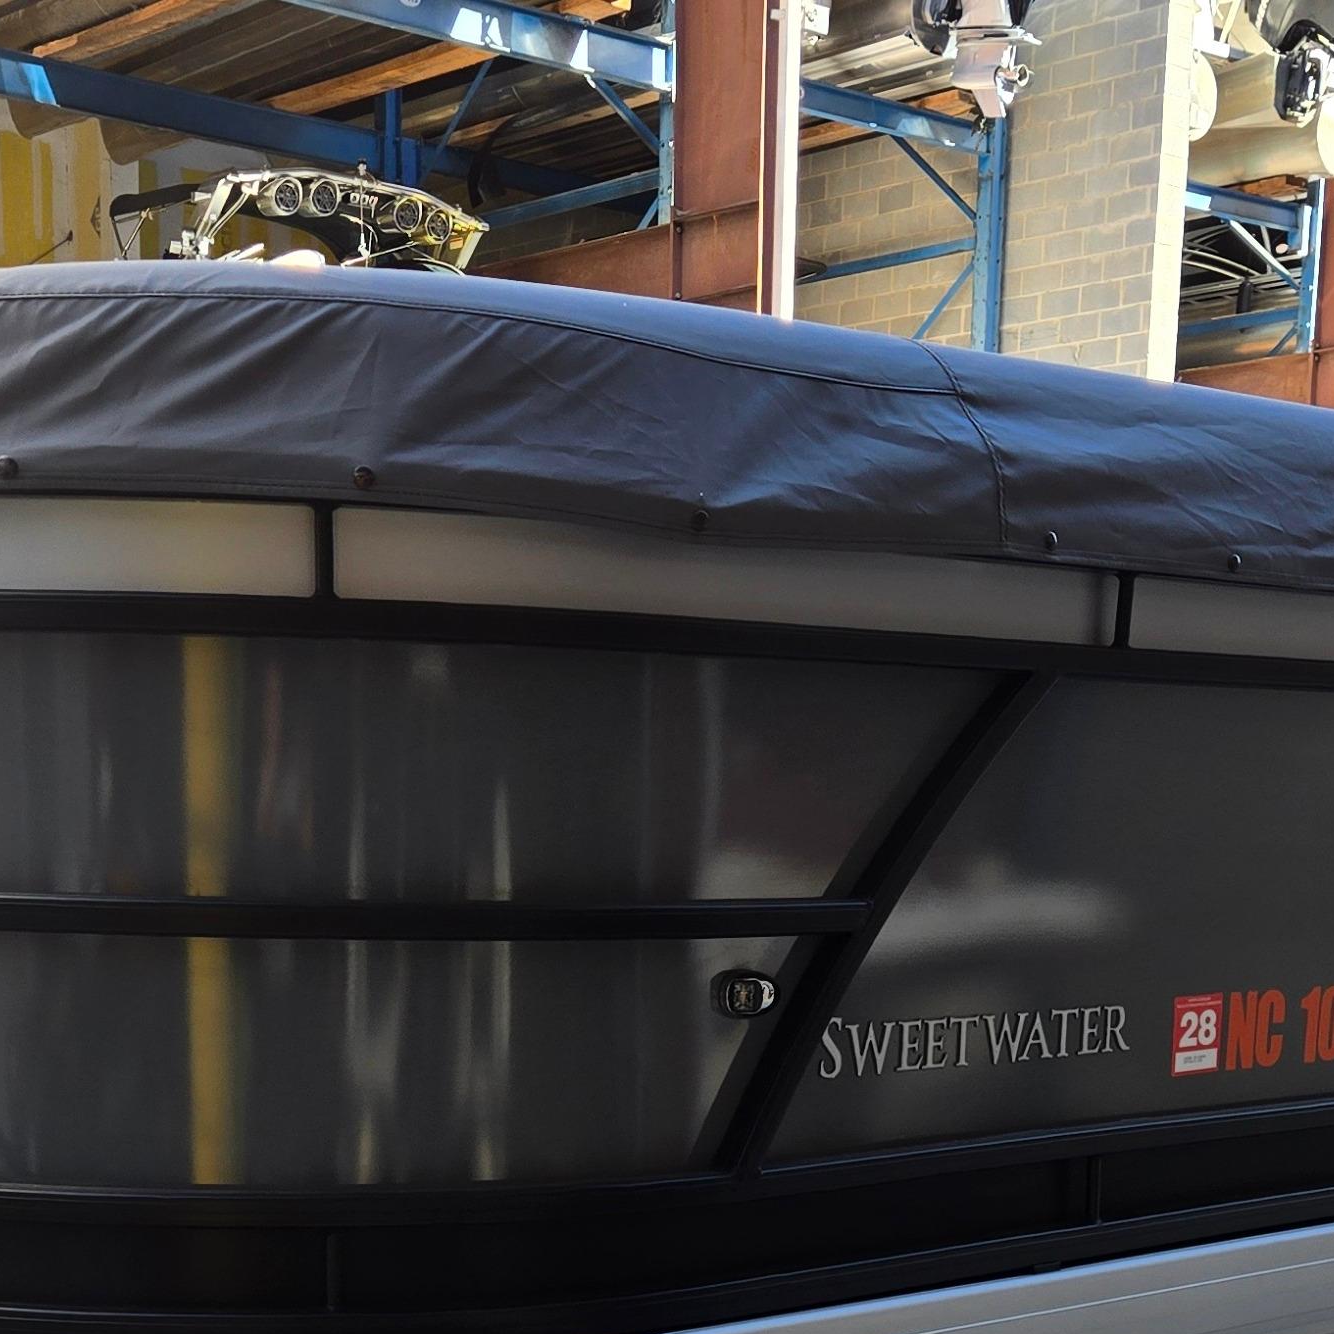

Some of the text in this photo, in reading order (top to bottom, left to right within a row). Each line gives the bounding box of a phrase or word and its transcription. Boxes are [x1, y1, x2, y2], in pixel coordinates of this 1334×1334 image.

[819, 1005, 1130, 1078] SWEETWATER
[1179, 1009, 1217, 1048] 28
[1225, 990, 1286, 1071] NC
